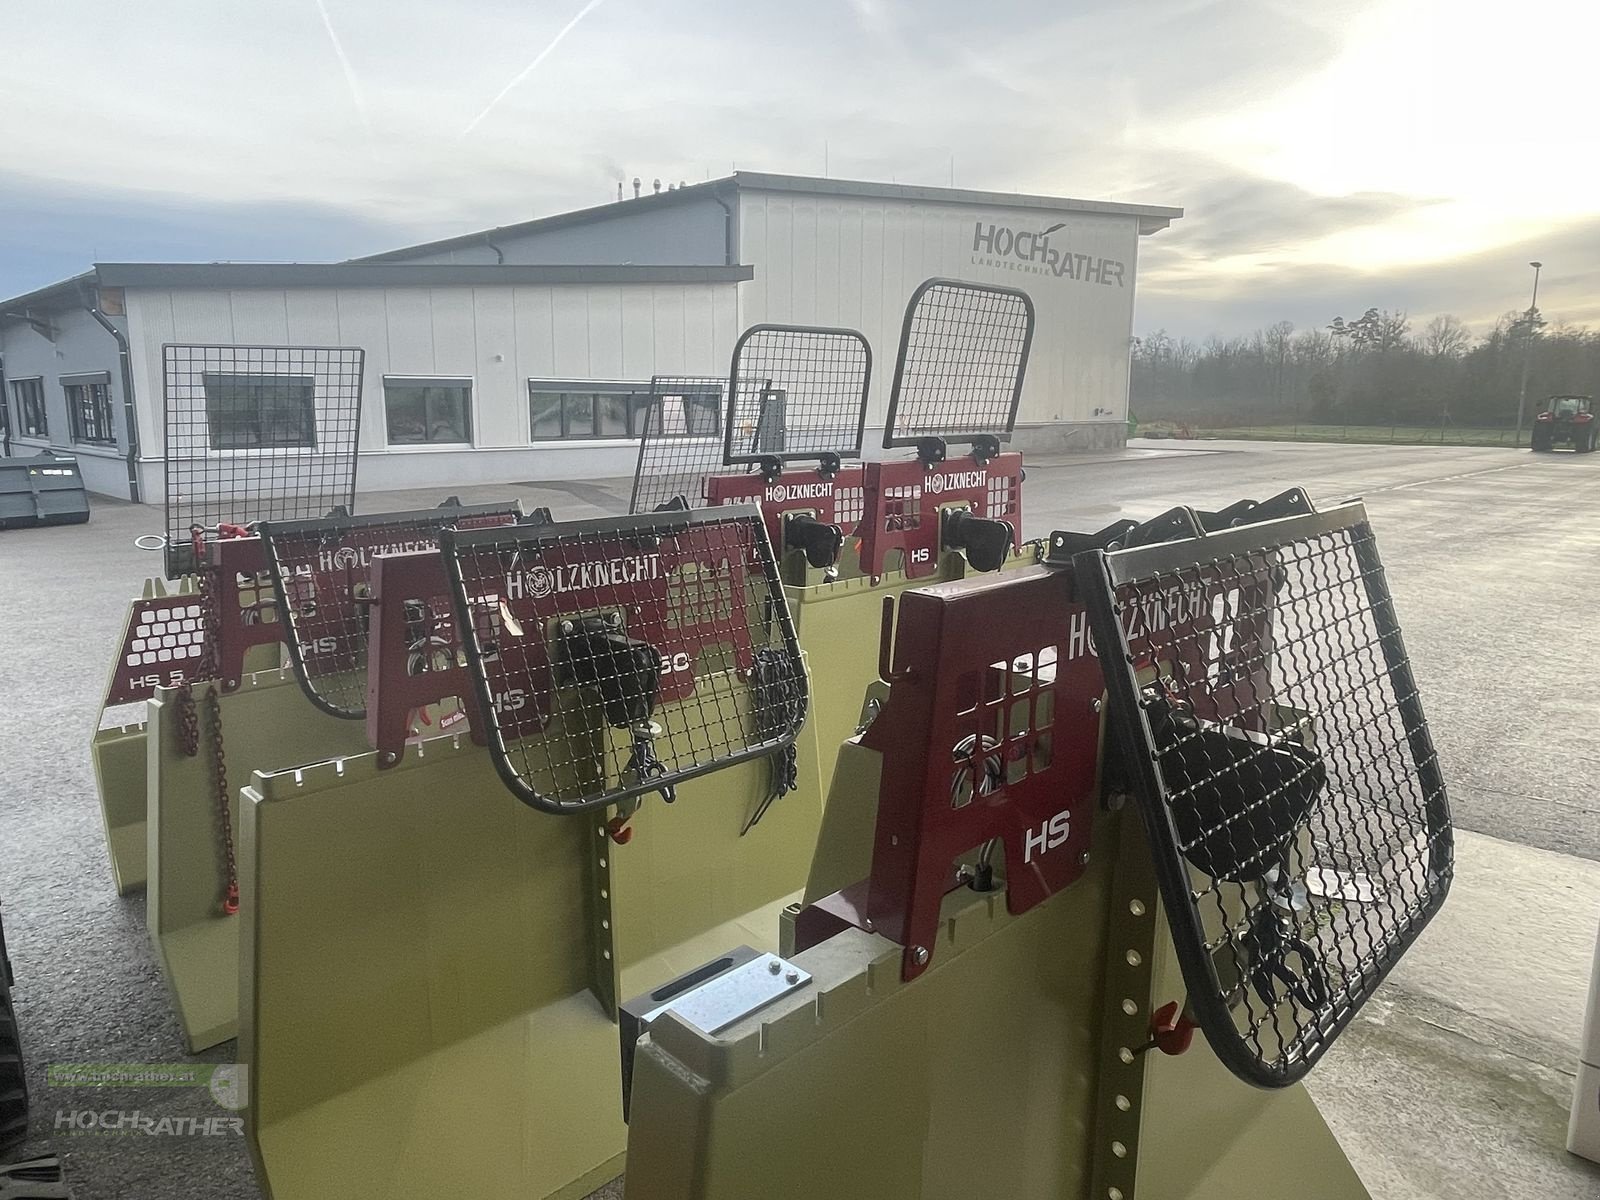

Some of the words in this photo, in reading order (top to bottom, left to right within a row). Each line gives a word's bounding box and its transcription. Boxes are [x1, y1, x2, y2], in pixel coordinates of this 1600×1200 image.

[971, 256, 1050, 277] LANDTECHNIK
[765, 482, 834, 503] HOLZKNECHT
[924, 470, 988, 494] HOLZKNECHT
[911, 548, 930, 563] HS
[506, 553, 660, 600] HOLZKNECHT
[301, 636, 337, 657] HS
[129, 674, 160, 690] HS
[169, 669, 184, 683] 5
[1024, 809, 1071, 864] HS
